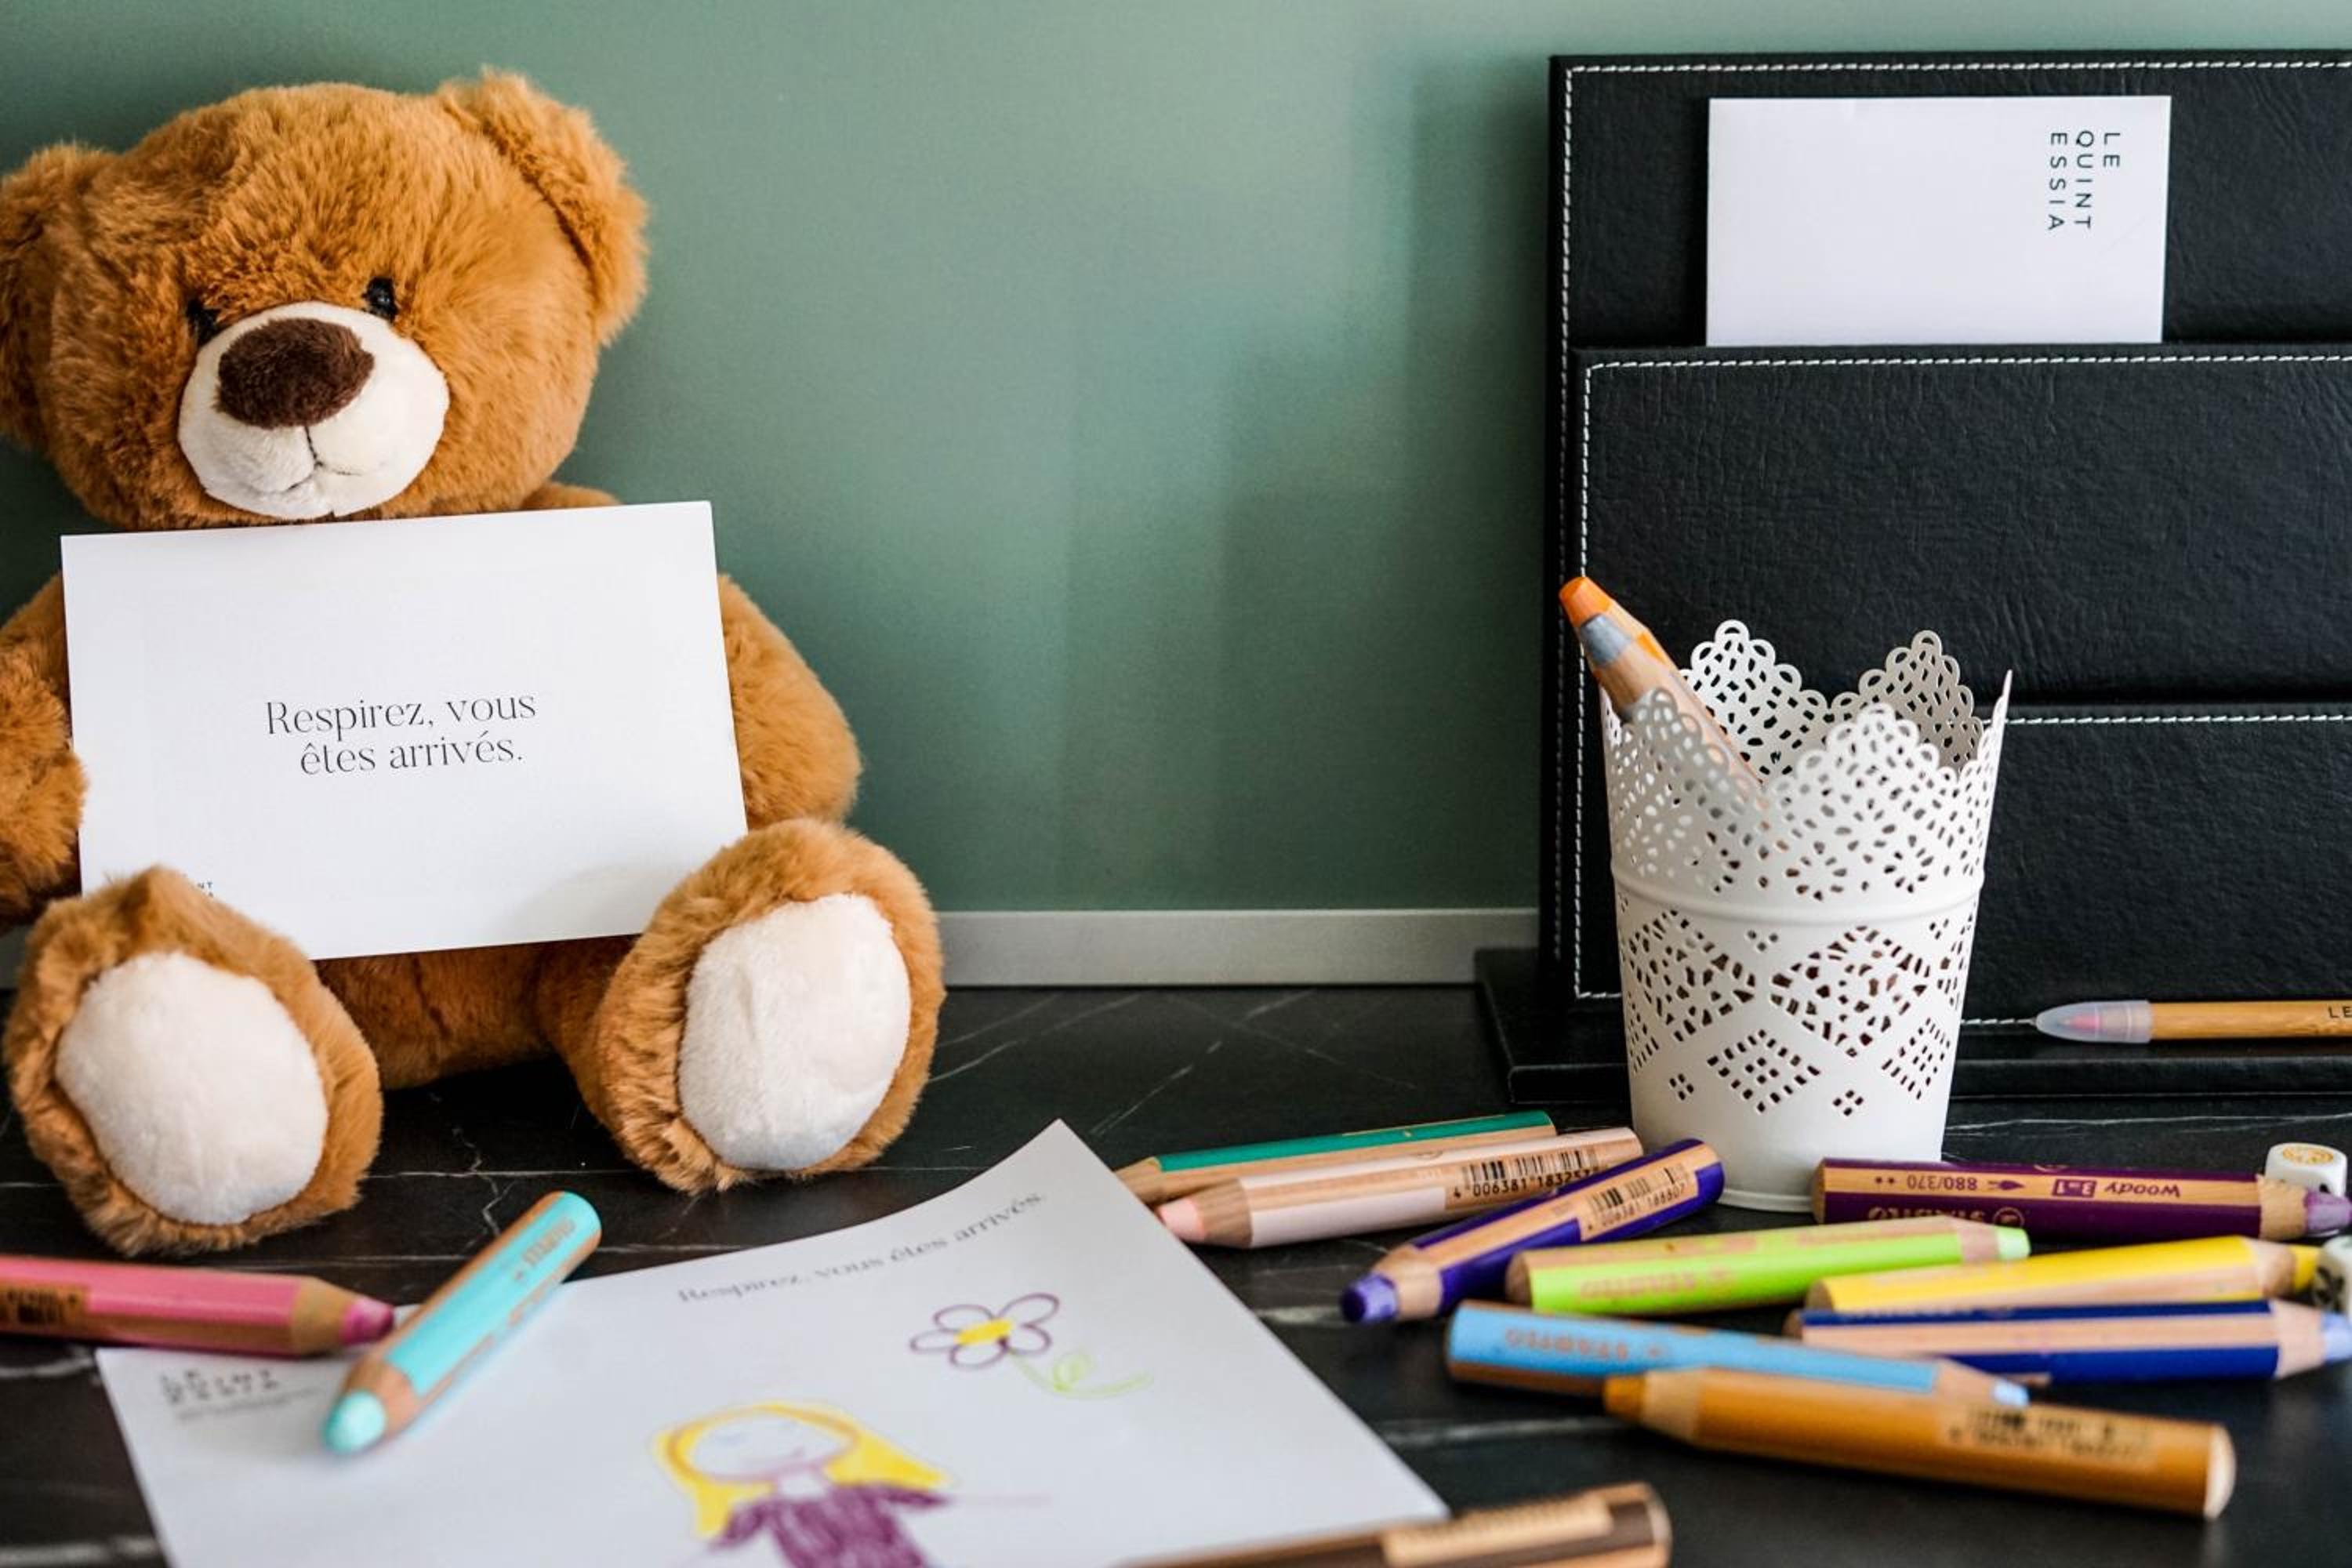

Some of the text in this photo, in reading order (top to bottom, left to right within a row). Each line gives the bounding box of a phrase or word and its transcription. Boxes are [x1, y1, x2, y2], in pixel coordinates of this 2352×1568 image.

[2103, 132, 2121, 168] LE
[2048, 132, 2067, 230] ESSIA
[2074, 130, 2094, 229] QUINT
[266, 694, 537, 742] Respirez, vous
[300, 730, 523, 775] êtes arrivés.
[2328, 1005, 2352, 1018] LE
[1473, 1178, 1527, 1197] 006381
[1907, 1175, 1978, 1191] 880/370
